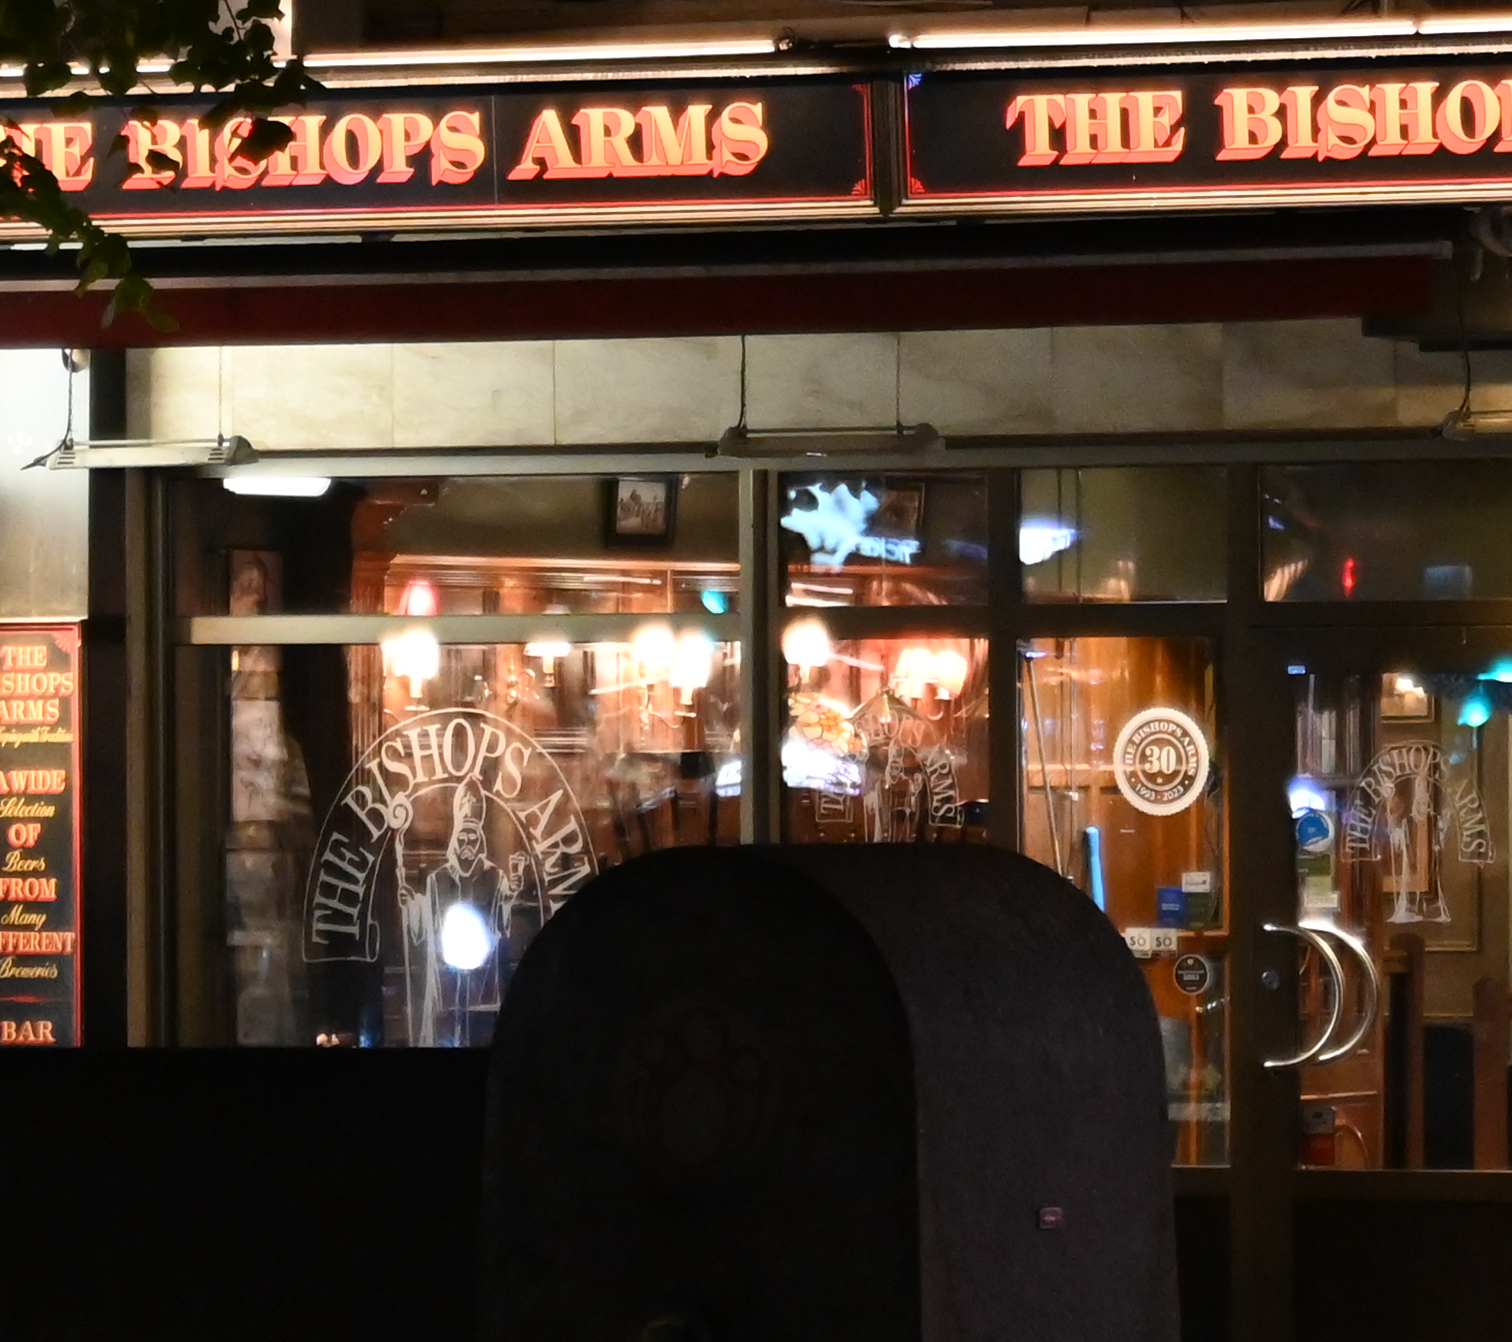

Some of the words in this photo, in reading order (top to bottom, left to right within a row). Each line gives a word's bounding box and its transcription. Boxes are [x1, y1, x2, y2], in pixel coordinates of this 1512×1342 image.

[508, 101, 769, 182] ARMS
[1006, 88, 1186, 167] THE
[0, 645, 48, 672] THE
[1124, 742, 1137, 776] THE
[1132, 721, 1185, 745] BISHOPS
[1180, 736, 1198, 777] ARMS
[1144, 745, 1177, 775] 30
[9, 770, 67, 795] WIDE
[341, 718, 532, 844] BISHOPS
[1360, 745, 1450, 804] BISHOPS
[1162, 784, 1185, 802] 2023
[8, 823, 42, 848] OF
[2, 848, 47, 873] Beers
[517, 789, 591, 916] ARM
[312, 831, 376, 945] THE
[0, 904, 48, 931] Many
[0, 1020, 57, 1045] BAR
